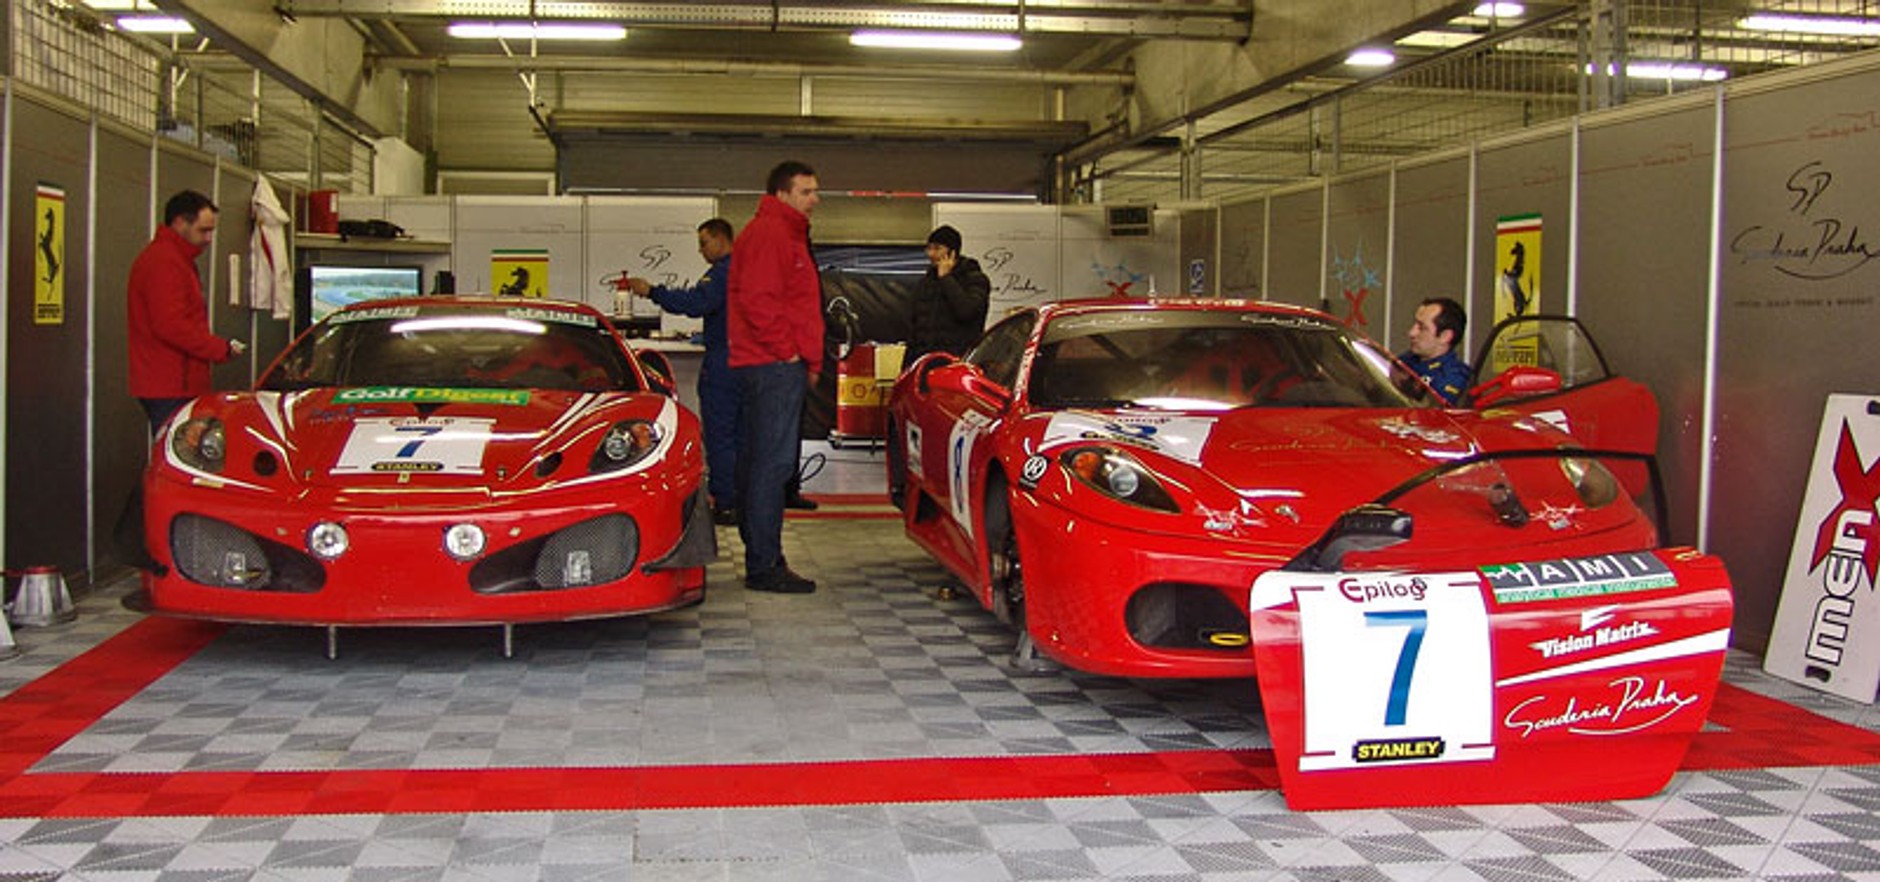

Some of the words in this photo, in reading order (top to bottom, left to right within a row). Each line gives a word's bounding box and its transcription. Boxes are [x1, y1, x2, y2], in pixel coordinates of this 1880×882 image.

[1786, 161, 1832, 215] SP
[340, 388, 414, 400] Golf
[413, 388, 521, 403] Digest
[395, 427, 443, 458] 7
[1338, 577, 1428, 603] Epilog
[1538, 636, 1593, 659] Vision
[1596, 620, 1654, 647] Matrix
[1363, 609, 1428, 727] 7
[1504, 696, 1611, 738] Scuderia
[1609, 677, 1699, 724] Praha
[1357, 740, 1440, 759] STANLEY
